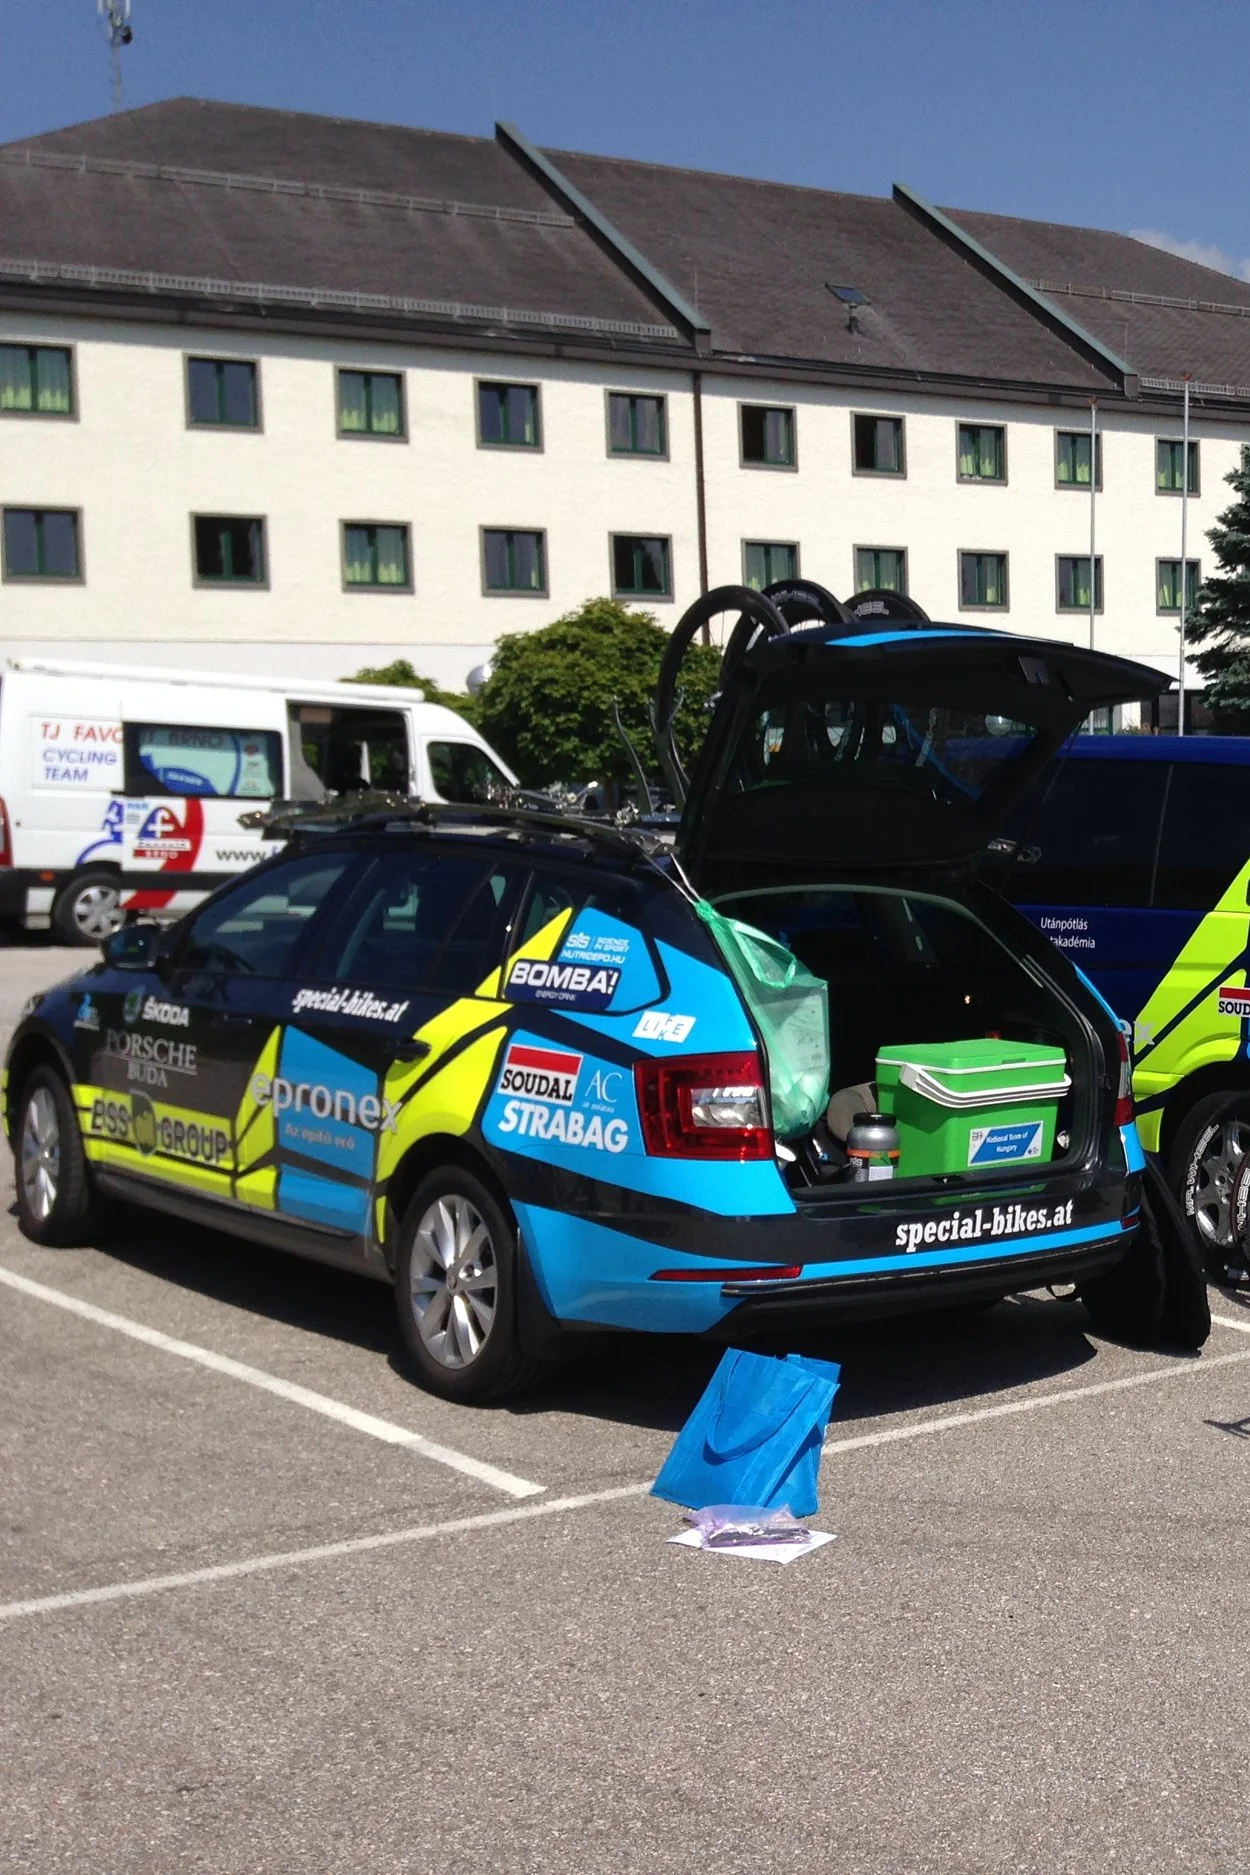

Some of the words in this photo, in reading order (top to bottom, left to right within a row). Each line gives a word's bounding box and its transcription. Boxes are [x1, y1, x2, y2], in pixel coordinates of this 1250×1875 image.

[41, 723, 60, 738] TJ
[43, 748, 117, 766] CYCLING
[44, 767, 88, 783] TEAM
[1040, 917, 1088, 931] Utánpótlás
[510, 963, 619, 994] BOMBA!
[142, 996, 189, 1027] ŠKODA
[291, 986, 410, 1023] special-bikes.at
[104, 1028, 198, 1070] PORSCHE
[127, 1063, 168, 1088] BUDA
[501, 1069, 573, 1102] SOUDAL
[585, 1069, 622, 1103] AC
[251, 1072, 403, 1136] epronex
[161, 1117, 229, 1162] GROUP
[498, 1100, 629, 1153] STRABAG
[986, 1134, 1008, 1143] National
[996, 1144, 1018, 1153] Hungary
[1185, 1123, 1221, 1186] WHEEL
[894, 1199, 1074, 1254] special-bikes.at
